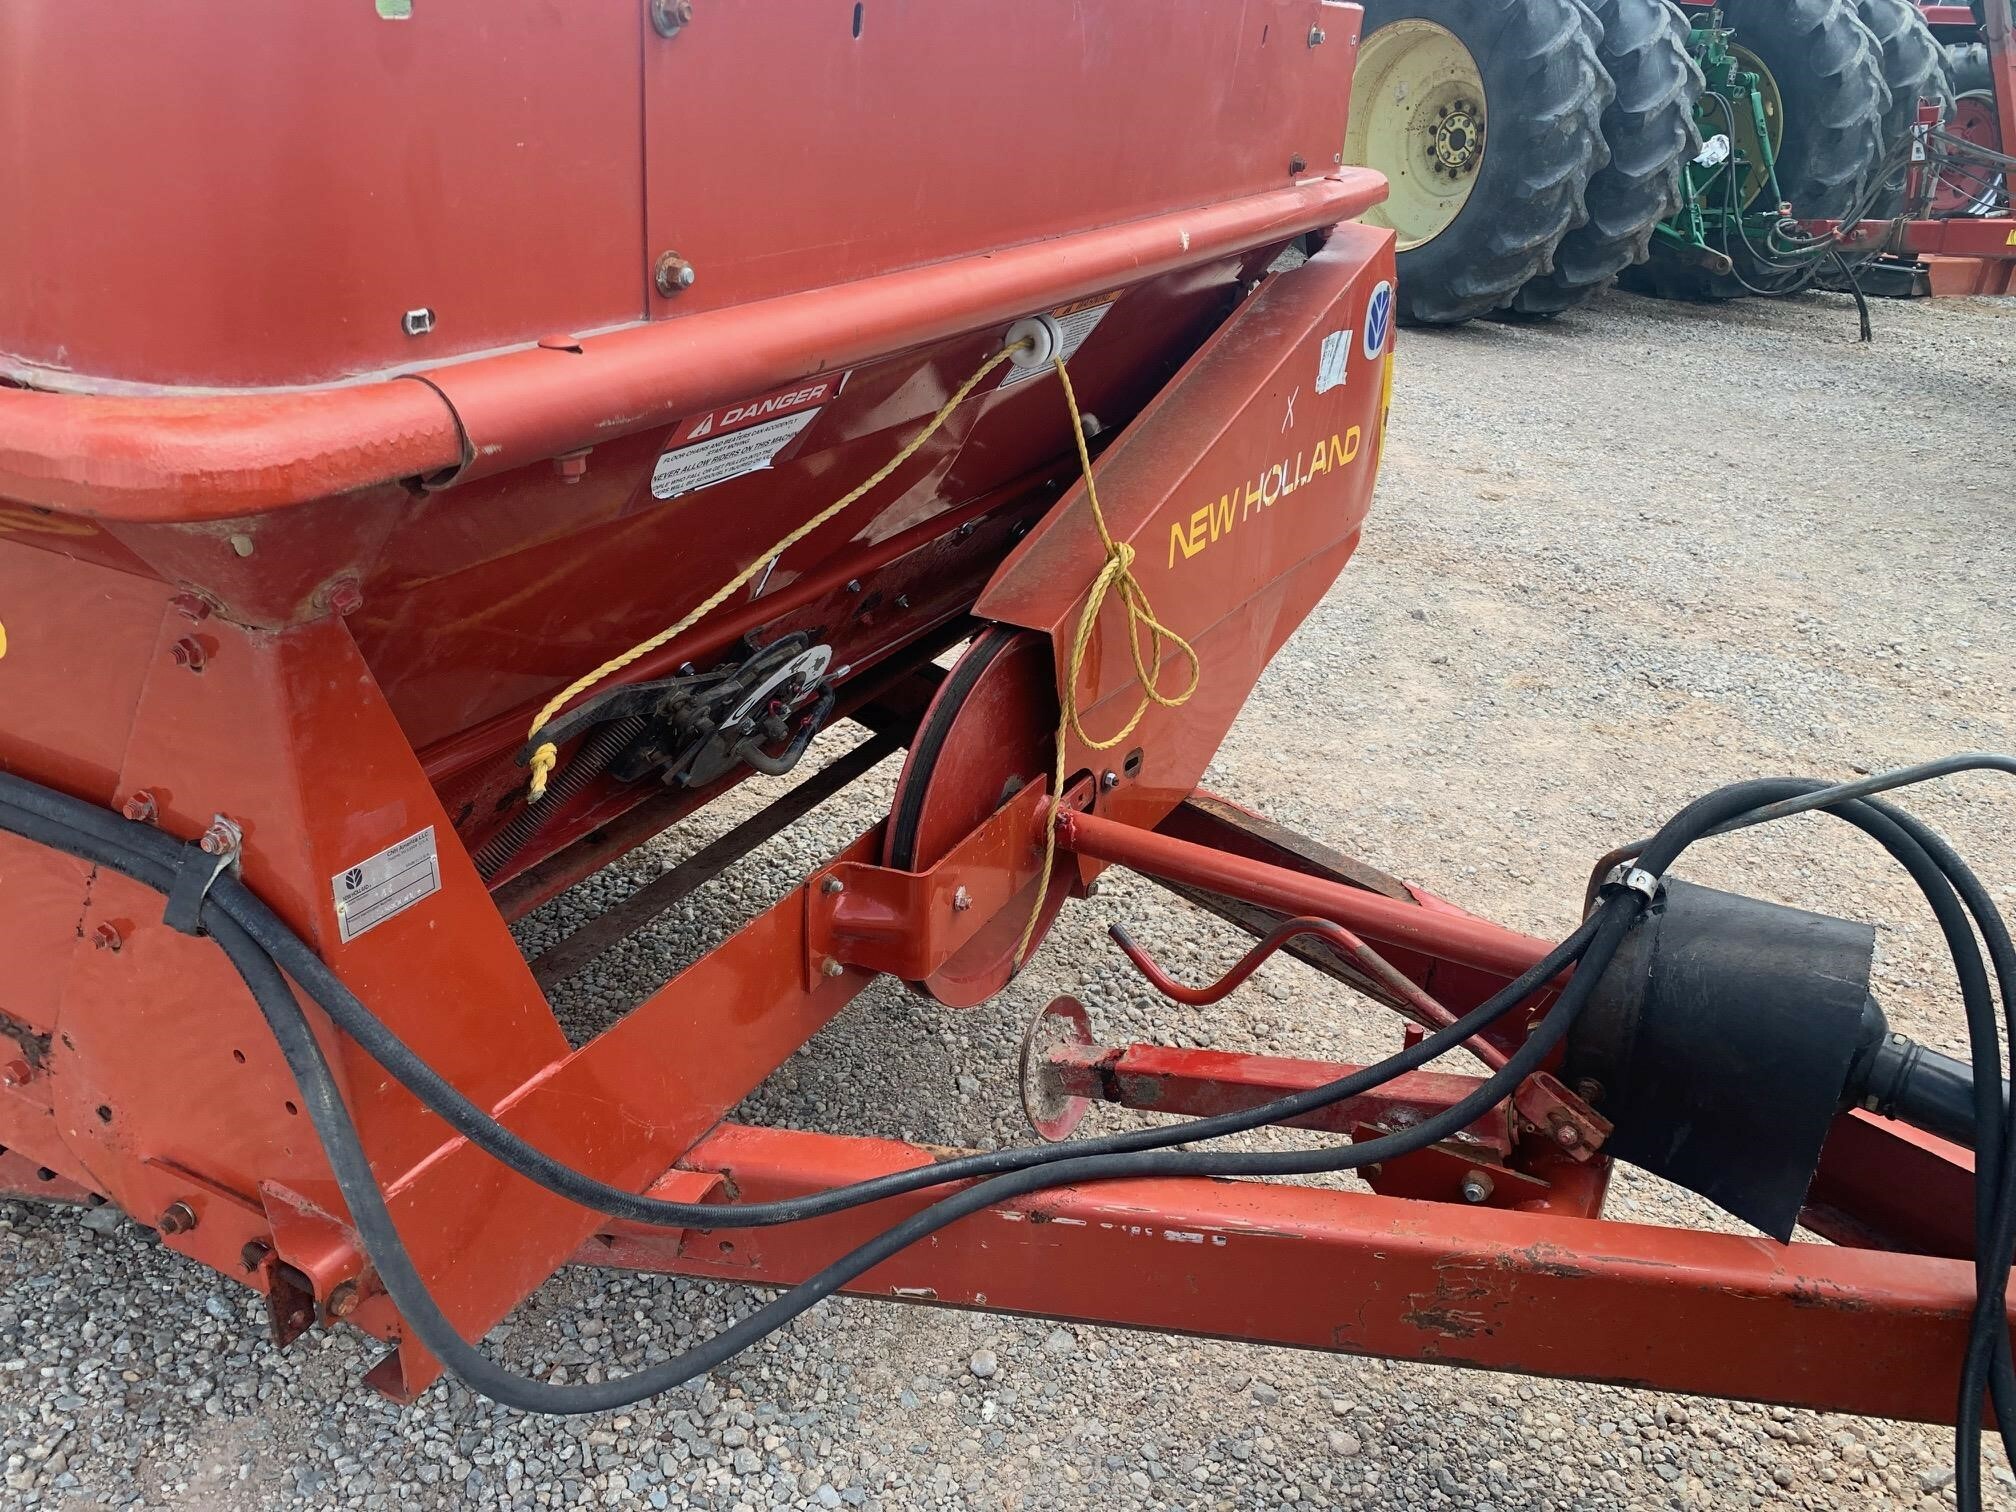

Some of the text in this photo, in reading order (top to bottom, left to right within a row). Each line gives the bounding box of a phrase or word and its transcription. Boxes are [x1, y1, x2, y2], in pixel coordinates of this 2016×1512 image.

[720, 384, 828, 427] DANGER
[653, 430, 800, 481] NEVER ALLOW RIDERS ON THIS MACHIN
[663, 452, 686, 464] FLOOR
[686, 445, 709, 457] CHAINS
[710, 440, 724, 449] AND
[723, 431, 751, 445] BEATERS
[751, 427, 765, 437] CAN
[706, 438, 751, 456] START MOVING
[653, 482, 671, 491] OPLE
[671, 476, 686, 486] WHO
[686, 471, 701, 481] FALL
[702, 467, 713, 475] OR
[713, 463, 725, 472] GET
[724, 456, 747, 468] PULLED
[1168, 425, 1361, 570] NEW HOLLAND
